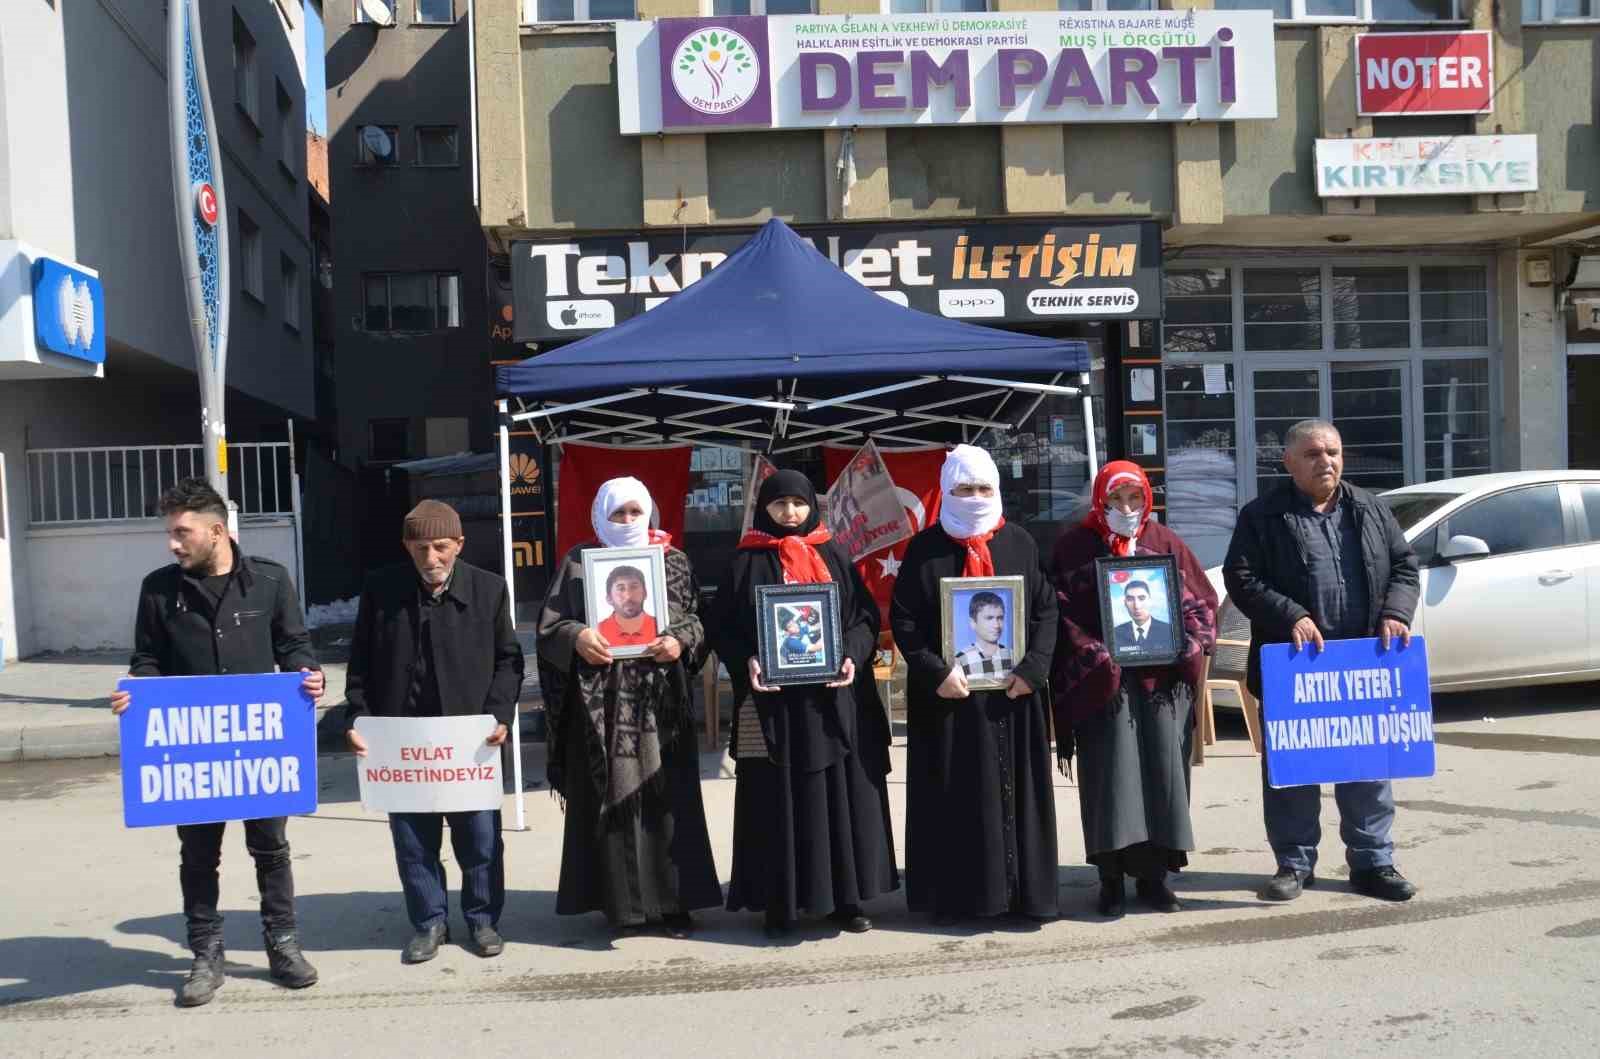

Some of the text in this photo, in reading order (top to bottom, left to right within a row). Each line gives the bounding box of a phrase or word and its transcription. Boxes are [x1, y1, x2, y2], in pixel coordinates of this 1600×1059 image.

[796, 34, 1028, 49] HALKLARIN EŞİTLİK VE DEMOKRASİ PARTİSİ
[841, 23, 877, 33] GELAN
[880, 22, 890, 33] A
[1059, 31, 1197, 50] MUŞ İL ÖRGÜTÜ
[799, 27, 1237, 112] DEM PARTİ
[1366, 56, 1483, 89] NOTER
[691, 95, 712, 110] DEM
[1324, 160, 1530, 189] KIRTASİYE
[530, 241, 730, 297] Tekn
[952, 233, 1137, 287] İLETİŞİM
[948, 298, 995, 307] oppo
[1031, 292, 1135, 307] TEKNİK SERVİS
[1294, 671, 1343, 703] ARTIK
[1344, 668, 1393, 700] YETER
[145, 703, 284, 747] ANNELER
[1266, 703, 1433, 752] YAKAMIZDAN DÜŞÜN
[401, 746, 454, 761] EVLAT
[140, 749, 301, 804] DİRENİYOR
[366, 763, 496, 783] NÖBETİNDEYİZ
